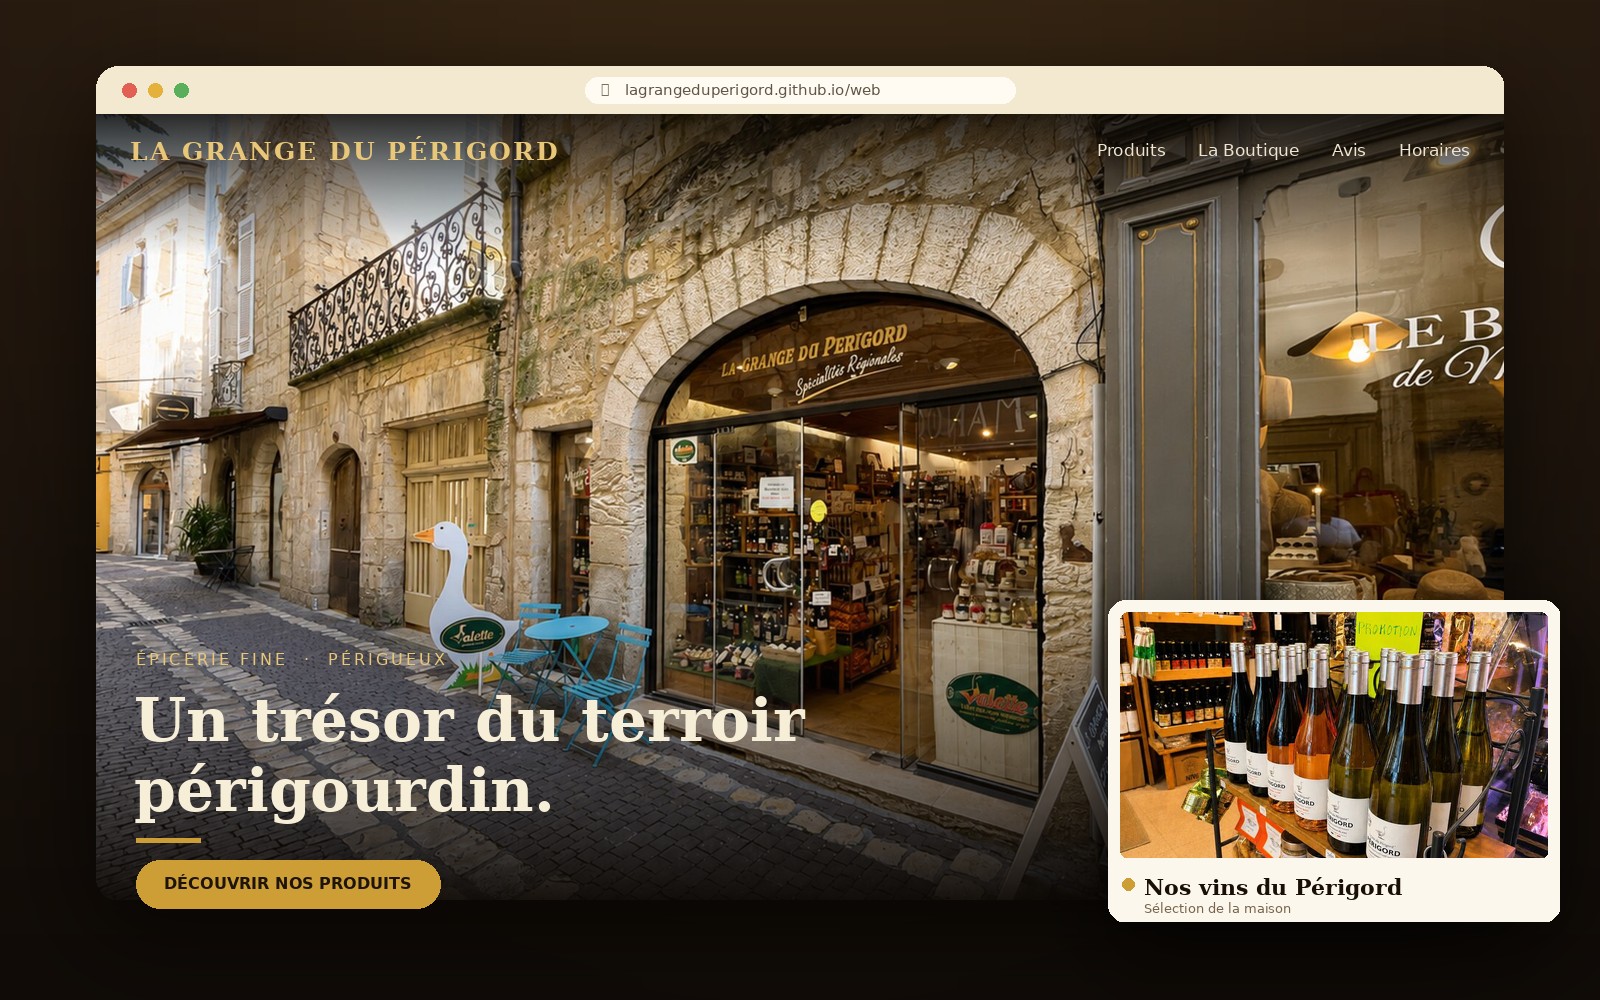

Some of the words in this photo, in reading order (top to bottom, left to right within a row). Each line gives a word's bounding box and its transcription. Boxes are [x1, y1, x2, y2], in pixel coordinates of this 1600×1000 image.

[1363, 314, 1445, 354] LE
[720, 361, 737, 378] LA
[741, 346, 796, 374] GRANGE
[1392, 358, 1435, 389] de
[1357, 621, 1418, 637] PROMOTION
